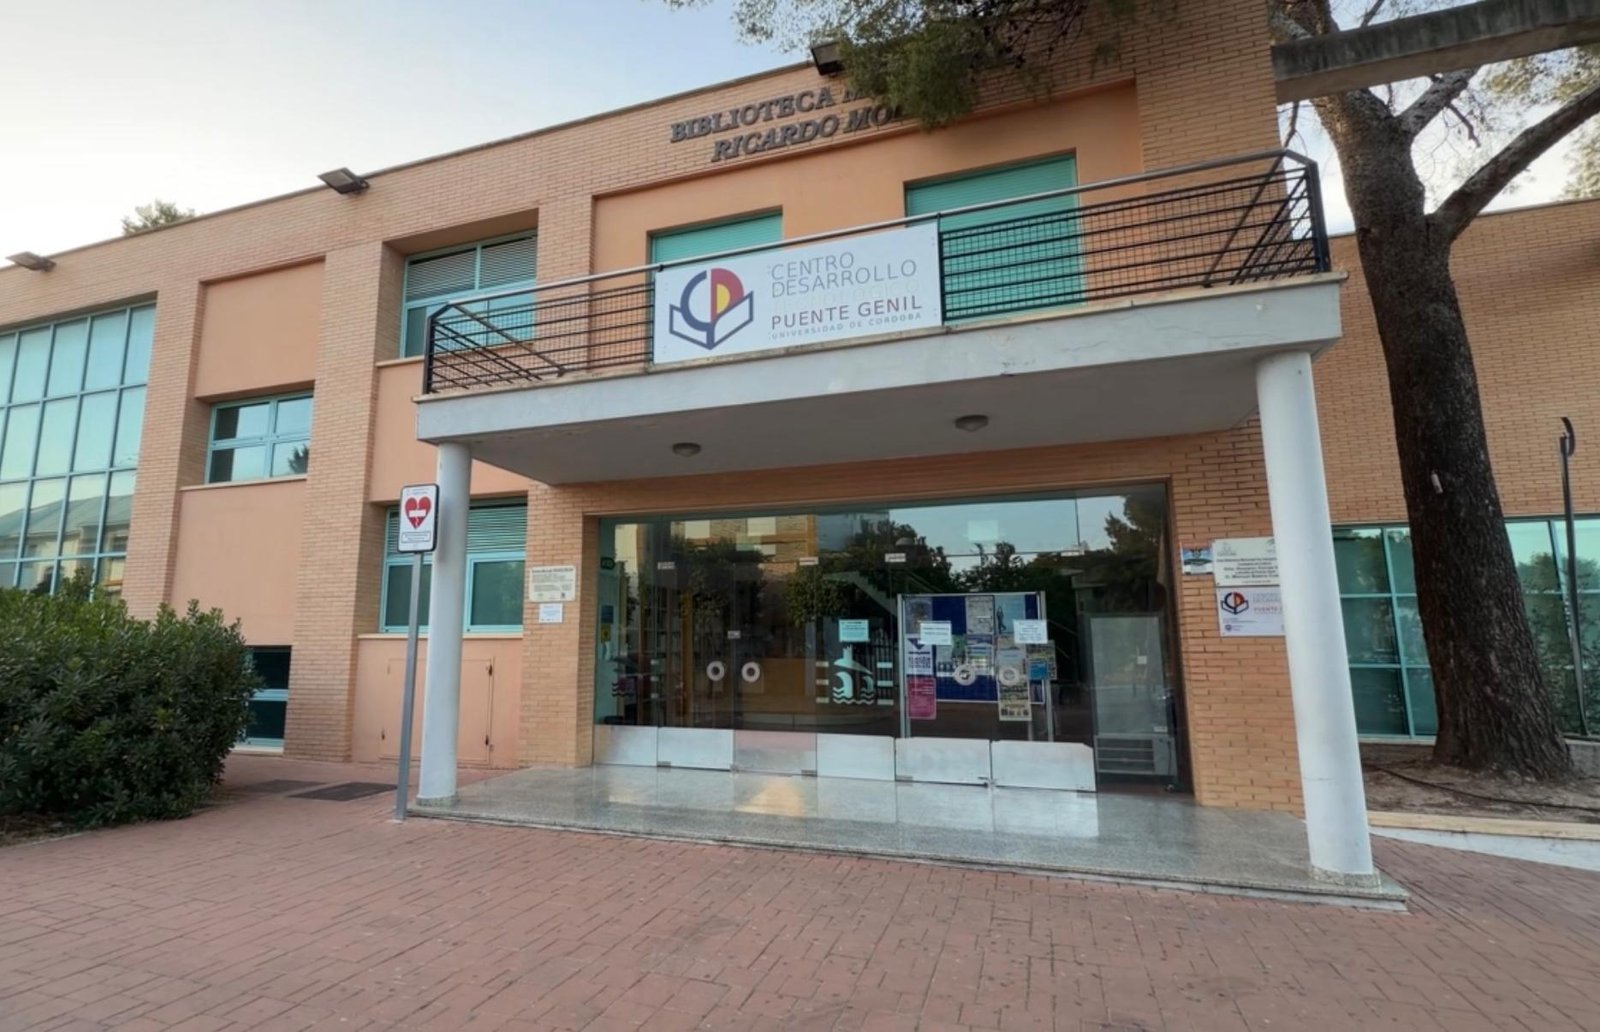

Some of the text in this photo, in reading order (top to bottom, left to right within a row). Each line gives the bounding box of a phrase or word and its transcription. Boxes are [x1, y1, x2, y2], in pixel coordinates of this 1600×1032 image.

[670, 86, 836, 143] BIBLIOTECA
[711, 114, 840, 162] RICARDO
[771, 251, 855, 281] CENTRO
[772, 259, 917, 298] DESARROLLO
[771, 295, 923, 330] PUENTE GENIL
[772, 323, 844, 340] UNIVERSIDAD
[849, 321, 863, 329] DE
